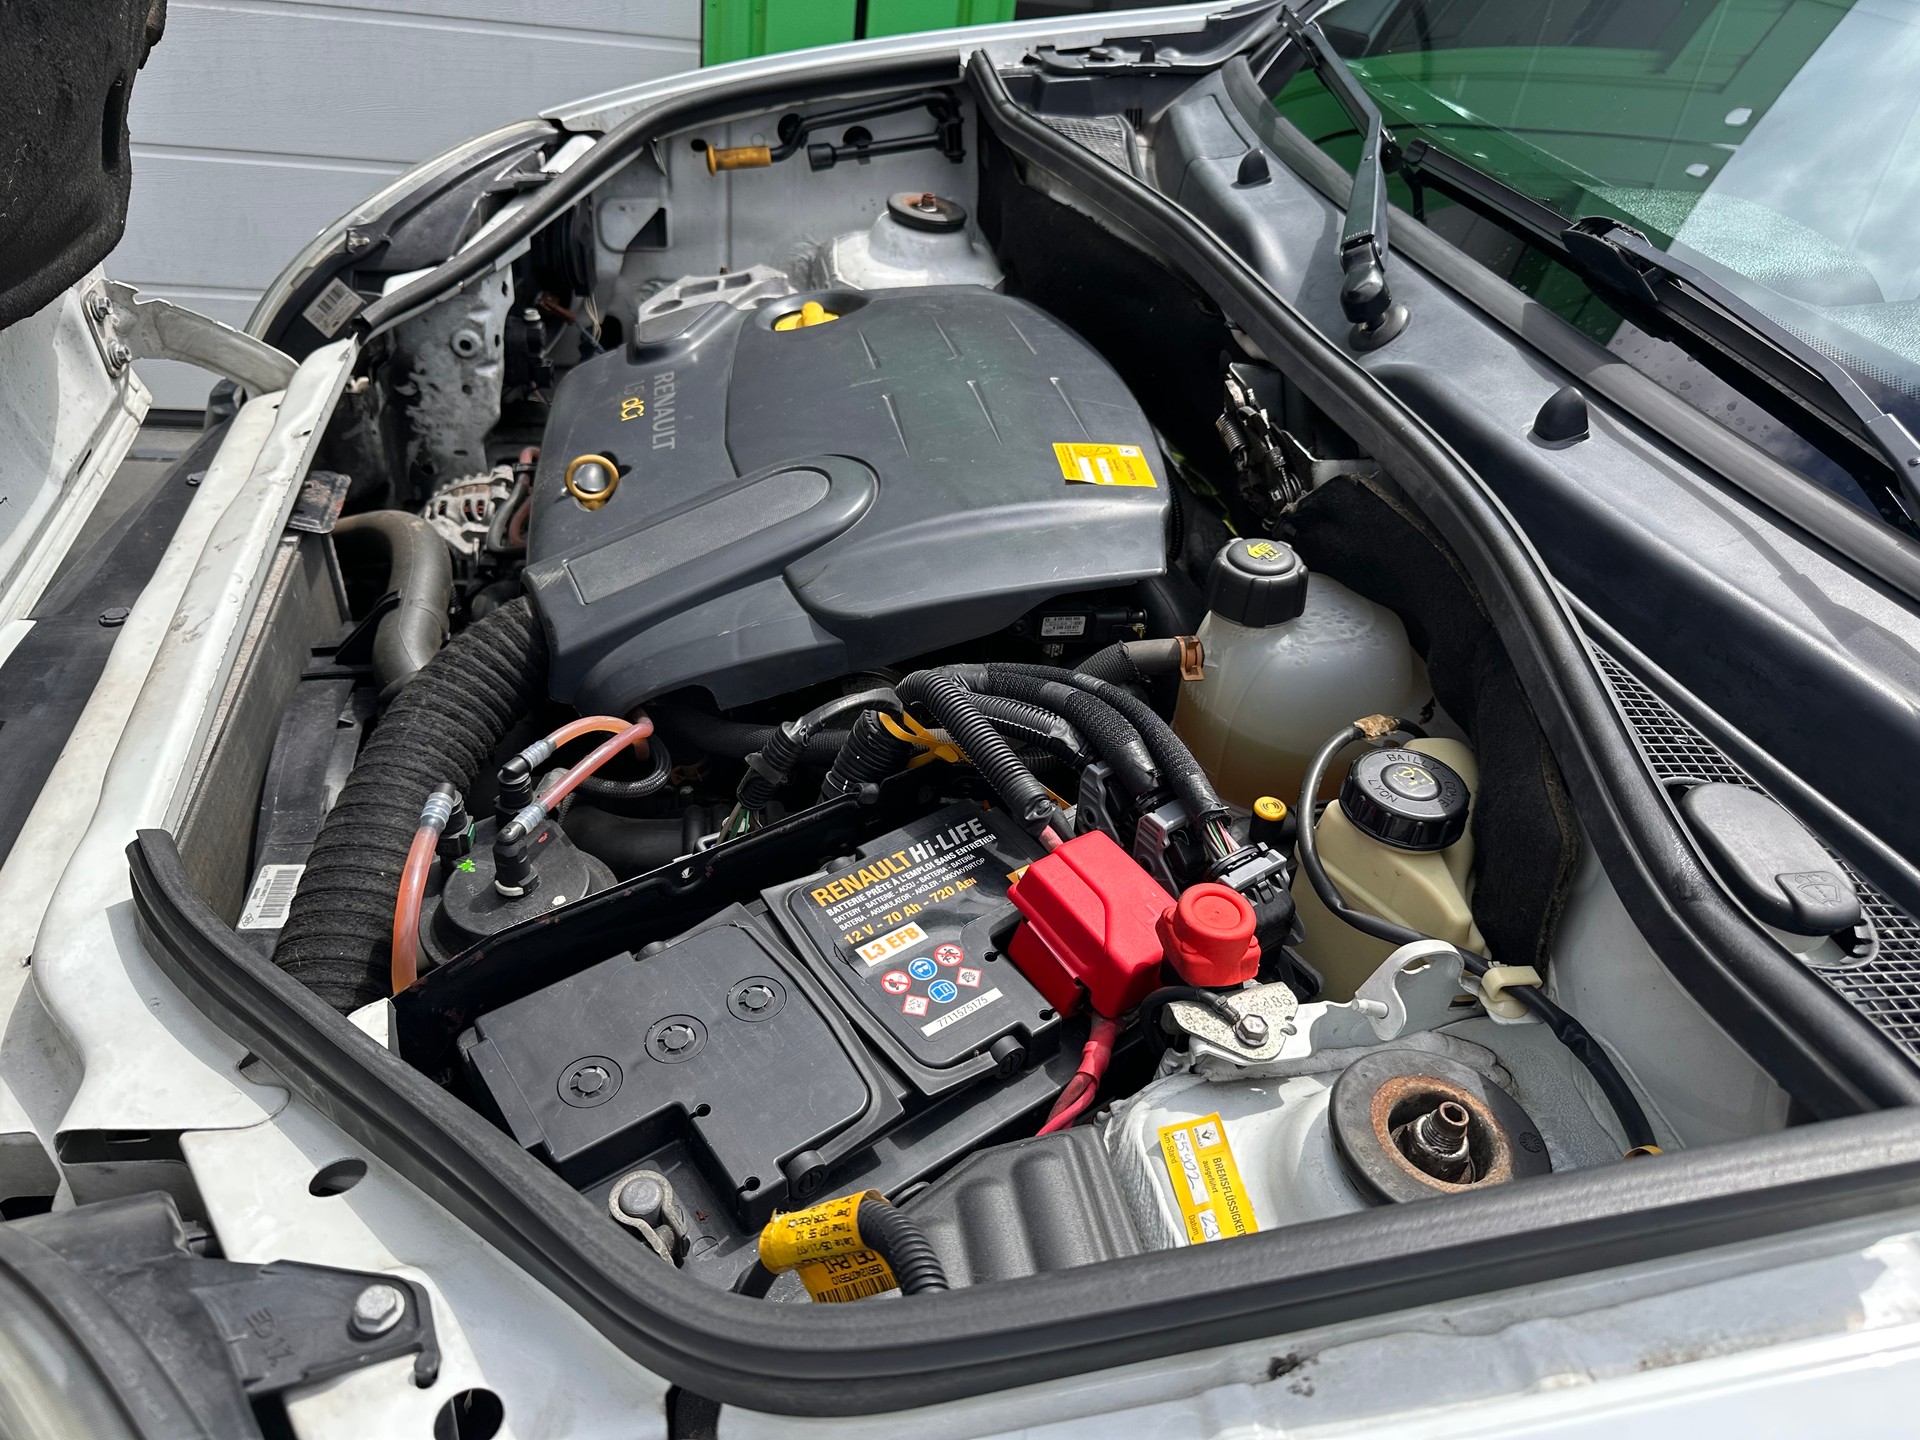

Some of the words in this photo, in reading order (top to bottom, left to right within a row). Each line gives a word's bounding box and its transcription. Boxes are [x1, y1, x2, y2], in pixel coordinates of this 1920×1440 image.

[621, 397, 645, 422] dCi
[652, 371, 676, 450] RENAULT
[1368, 779, 1398, 803] LYON
[811, 850, 911, 907] RENAULT
[908, 817, 986, 863] Hi-LIFE
[825, 894, 867, 917] BATTERIE
[865, 881, 893, 899] PRÊTE
[891, 878, 900, 886] À
[901, 862, 935, 882] L'EMPLOI
[933, 852, 956, 866] SANS
[955, 833, 997, 856] ENTRETIEN
[833, 907, 863, 924] BATTERY
[866, 891, 895, 909] BATTERIE
[899, 881, 916, 893] ACCU
[918, 866, 948, 883] BATTERIA
[839, 914, 867, 931] BATERIA
[870, 893, 912, 916] AKUMULATOR
[915, 881, 939, 895] AKÜLER
[844, 930, 864, 944] 12
[862, 924, 874, 936] V
[883, 911, 902, 926] 70
[903, 902, 922, 917] Ah
[929, 886, 955, 903] 720
[862, 942, 887, 962] L3
[885, 926, 920, 949] EFB
[937, 996, 988, 1027] 7711575175
[1163, 1132, 1178, 1164] km-Stand
[1202, 1160, 1218, 1193] ausgeführt
[1213, 1157, 1246, 1237] BREMSFLÜSSIGKEIT
[1189, 1214, 1199, 1236] Datum
[827, 1251, 876, 1274] DELPHI
